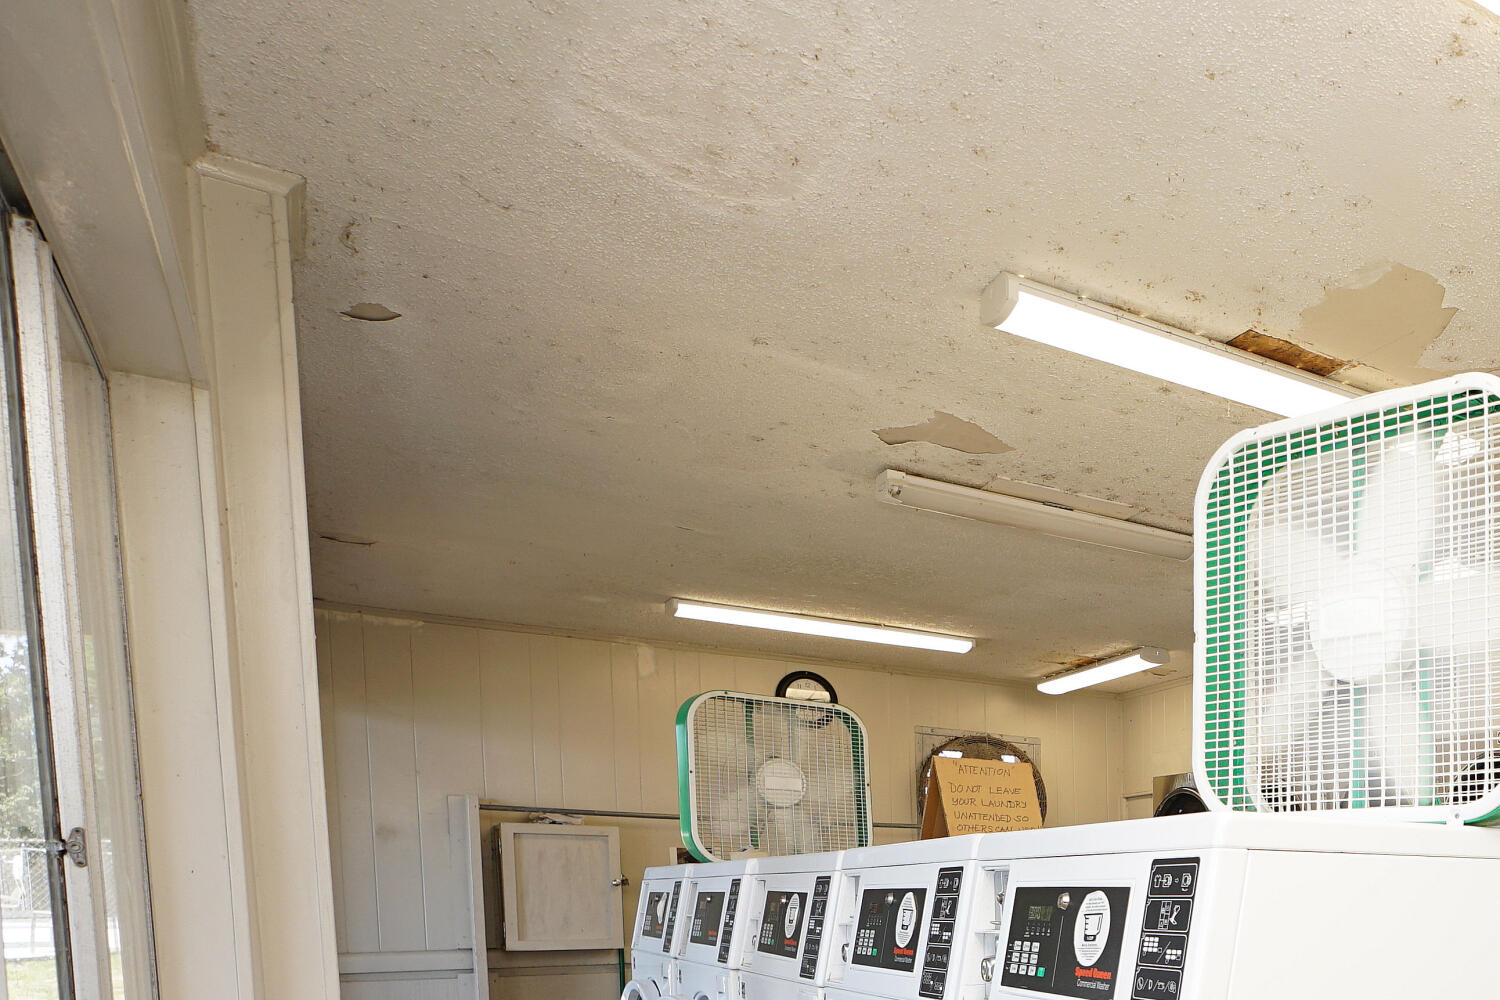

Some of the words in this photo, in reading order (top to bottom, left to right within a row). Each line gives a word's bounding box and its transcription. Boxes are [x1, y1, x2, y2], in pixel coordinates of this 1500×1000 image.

[948, 781, 964, 793] DO
[965, 784, 982, 794] NOT
[989, 785, 1022, 795] LEAVE
[951, 797, 977, 807] YOUR
[981, 799, 1027, 809] LAUNDRY
[953, 811, 1012, 823] UNATTENDED
[1013, 815, 1030, 823] SO
[956, 823, 993, 834] OTHERS
[1074, 966, 1093, 978] Speed
